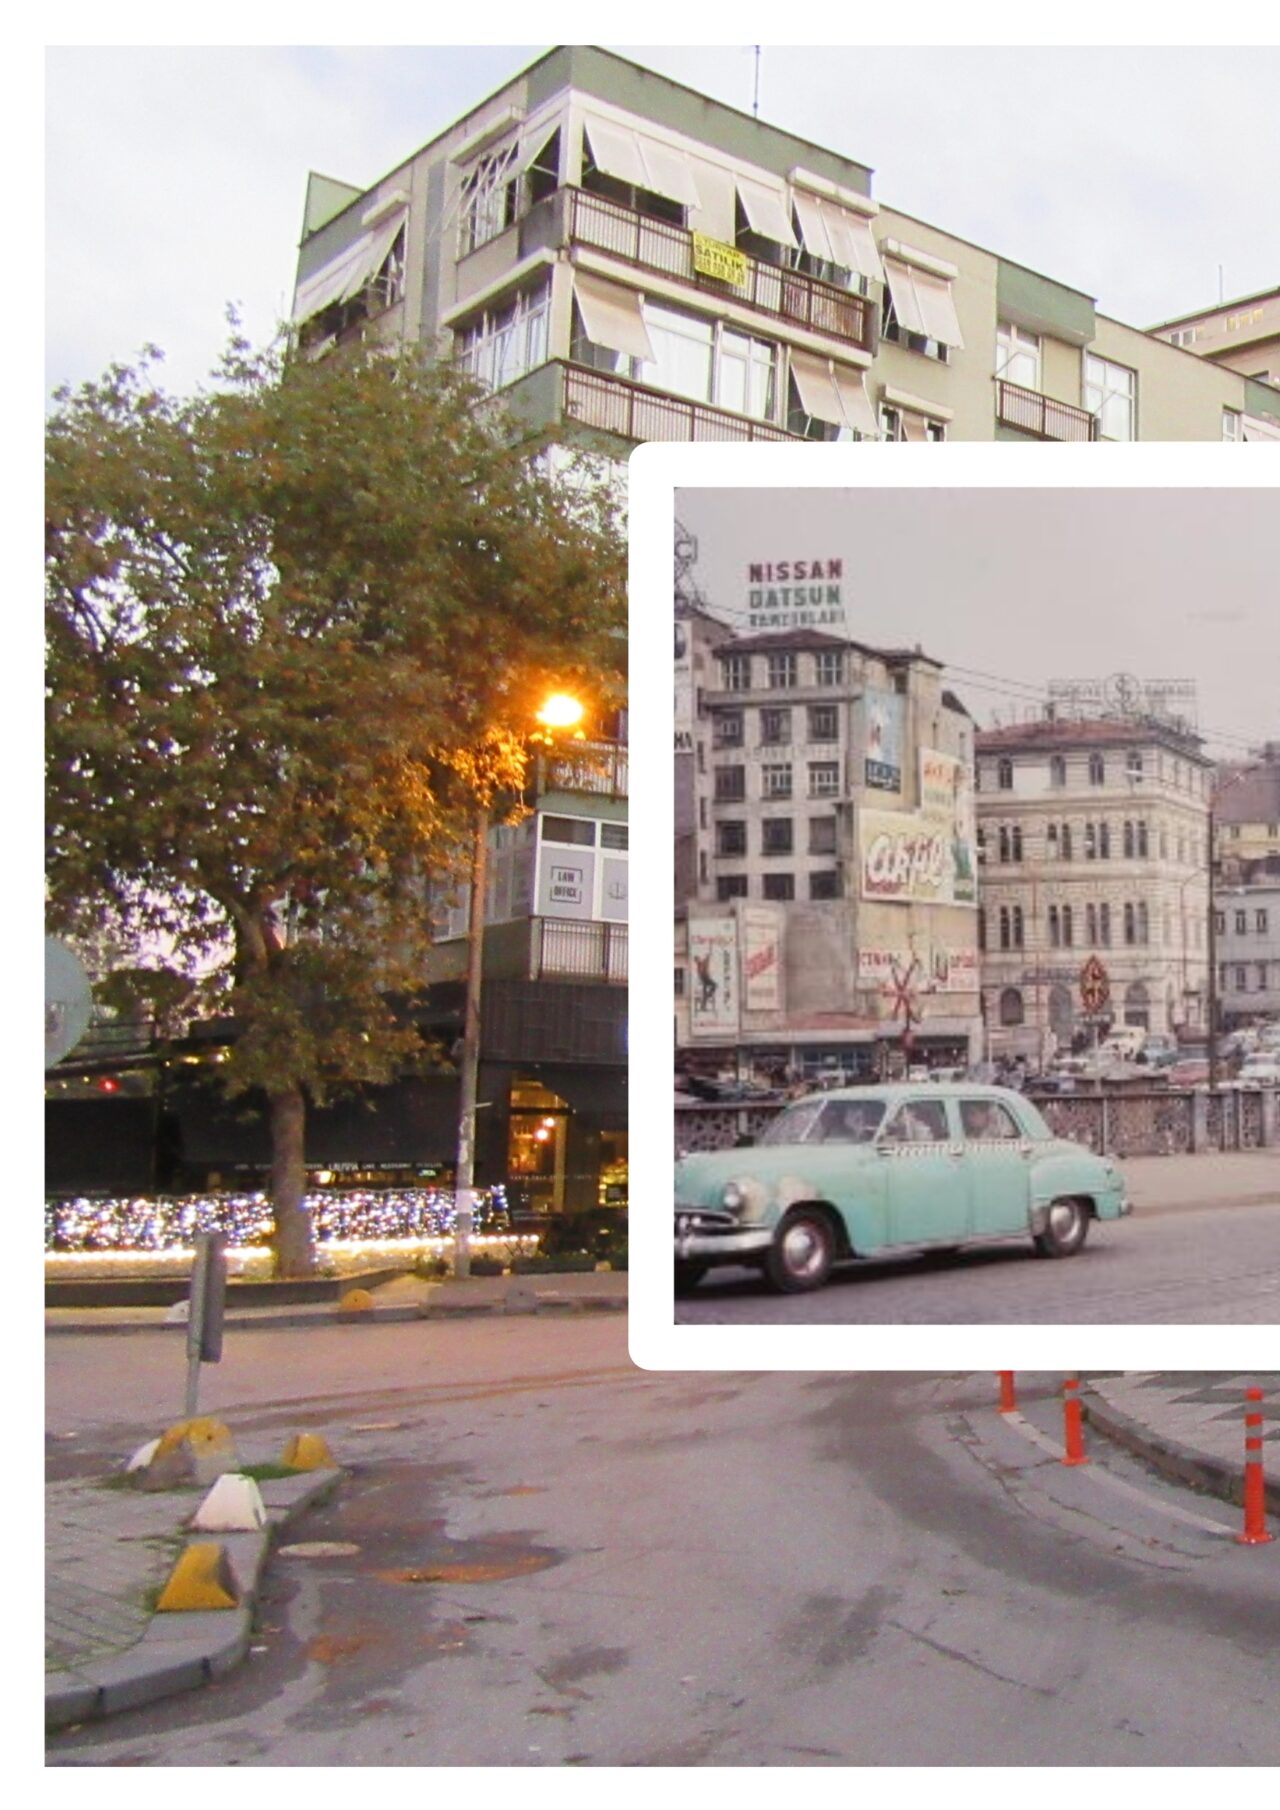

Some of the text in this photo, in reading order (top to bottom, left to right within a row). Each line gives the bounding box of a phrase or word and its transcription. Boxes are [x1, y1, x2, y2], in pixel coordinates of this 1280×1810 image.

[695, 244, 743, 273] SATILIK
[749, 559, 843, 583] NISSAN
[749, 585, 840, 609] DATSUN
[558, 871, 575, 883] LAW
[553, 885, 577, 898] OFFICE
